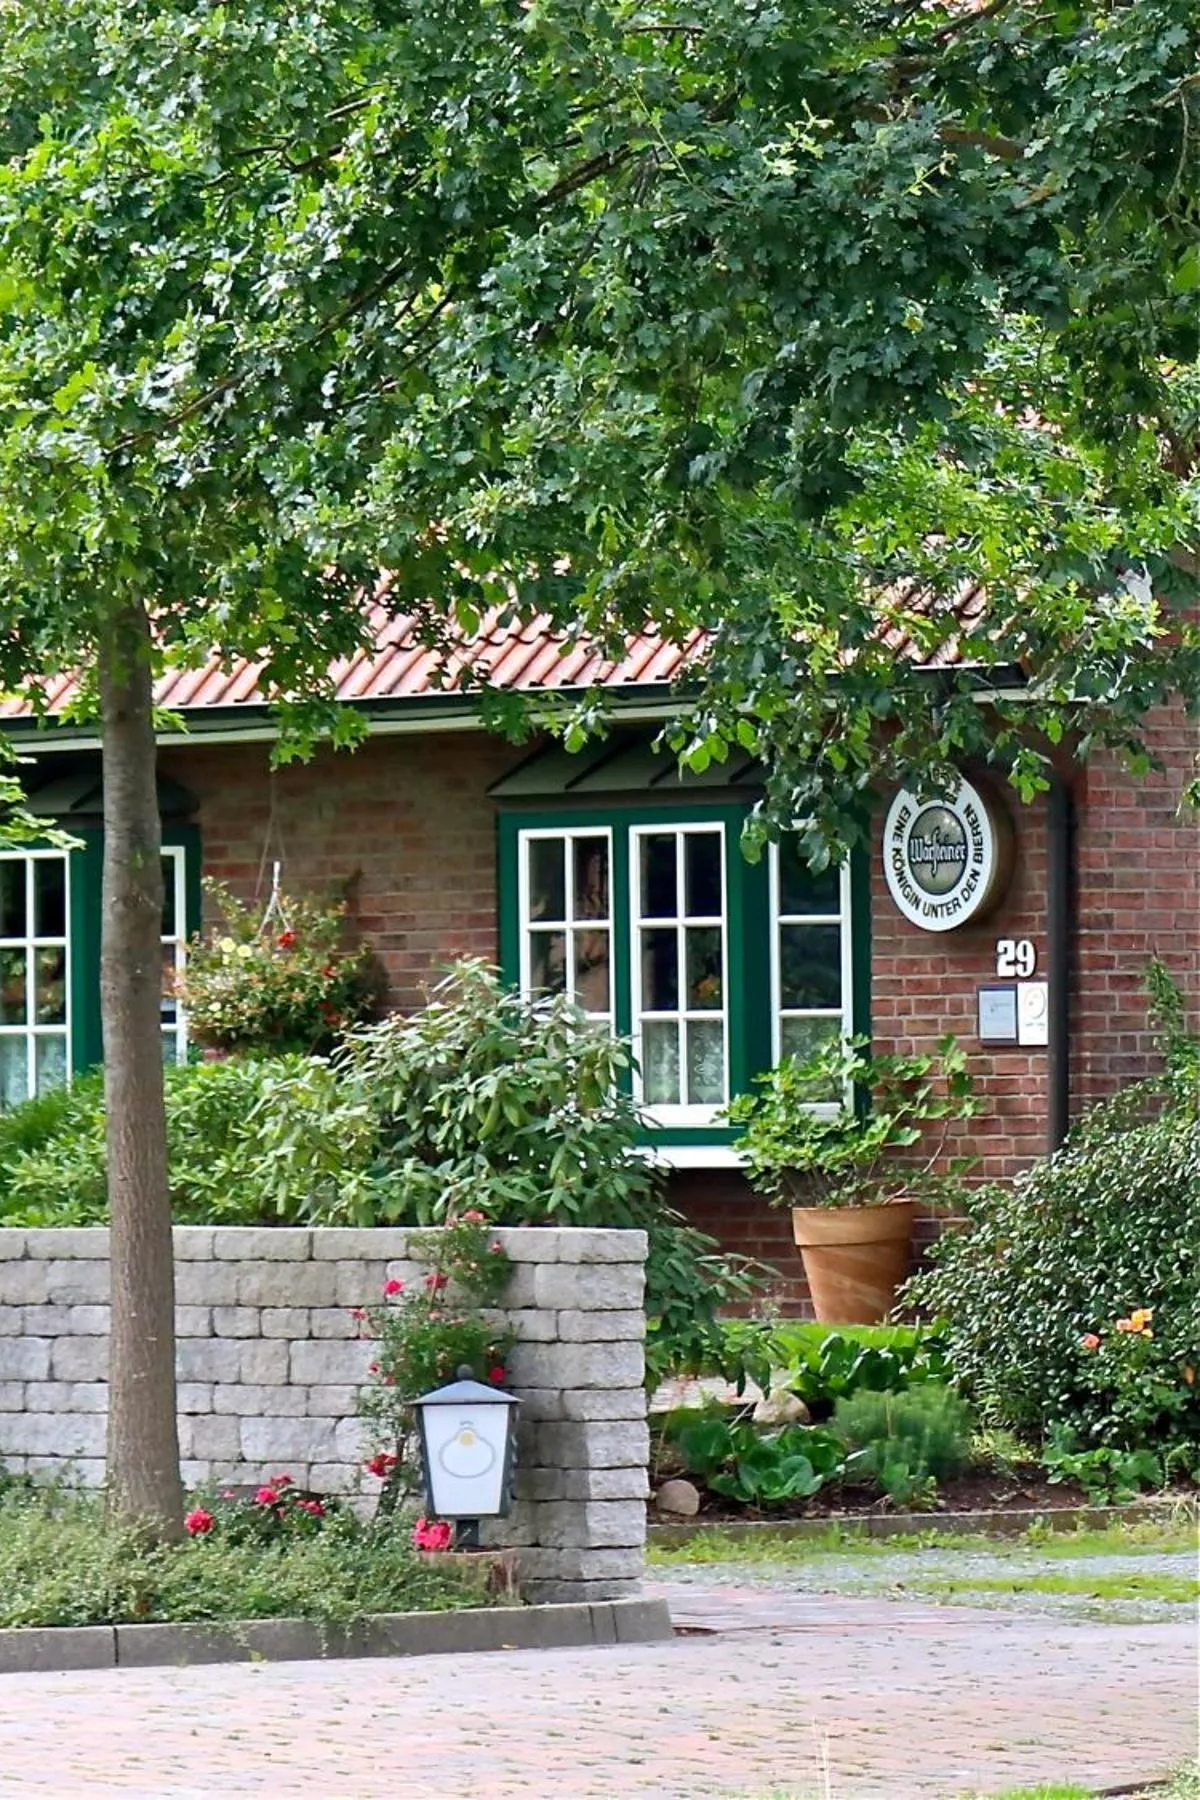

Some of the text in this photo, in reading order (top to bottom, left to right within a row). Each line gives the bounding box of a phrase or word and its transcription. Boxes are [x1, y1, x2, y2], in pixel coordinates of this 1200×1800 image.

[892, 803, 984, 919] EINE KÖNIGIN UNTER DEN BIEREN
[997, 940, 1036, 978] 29
